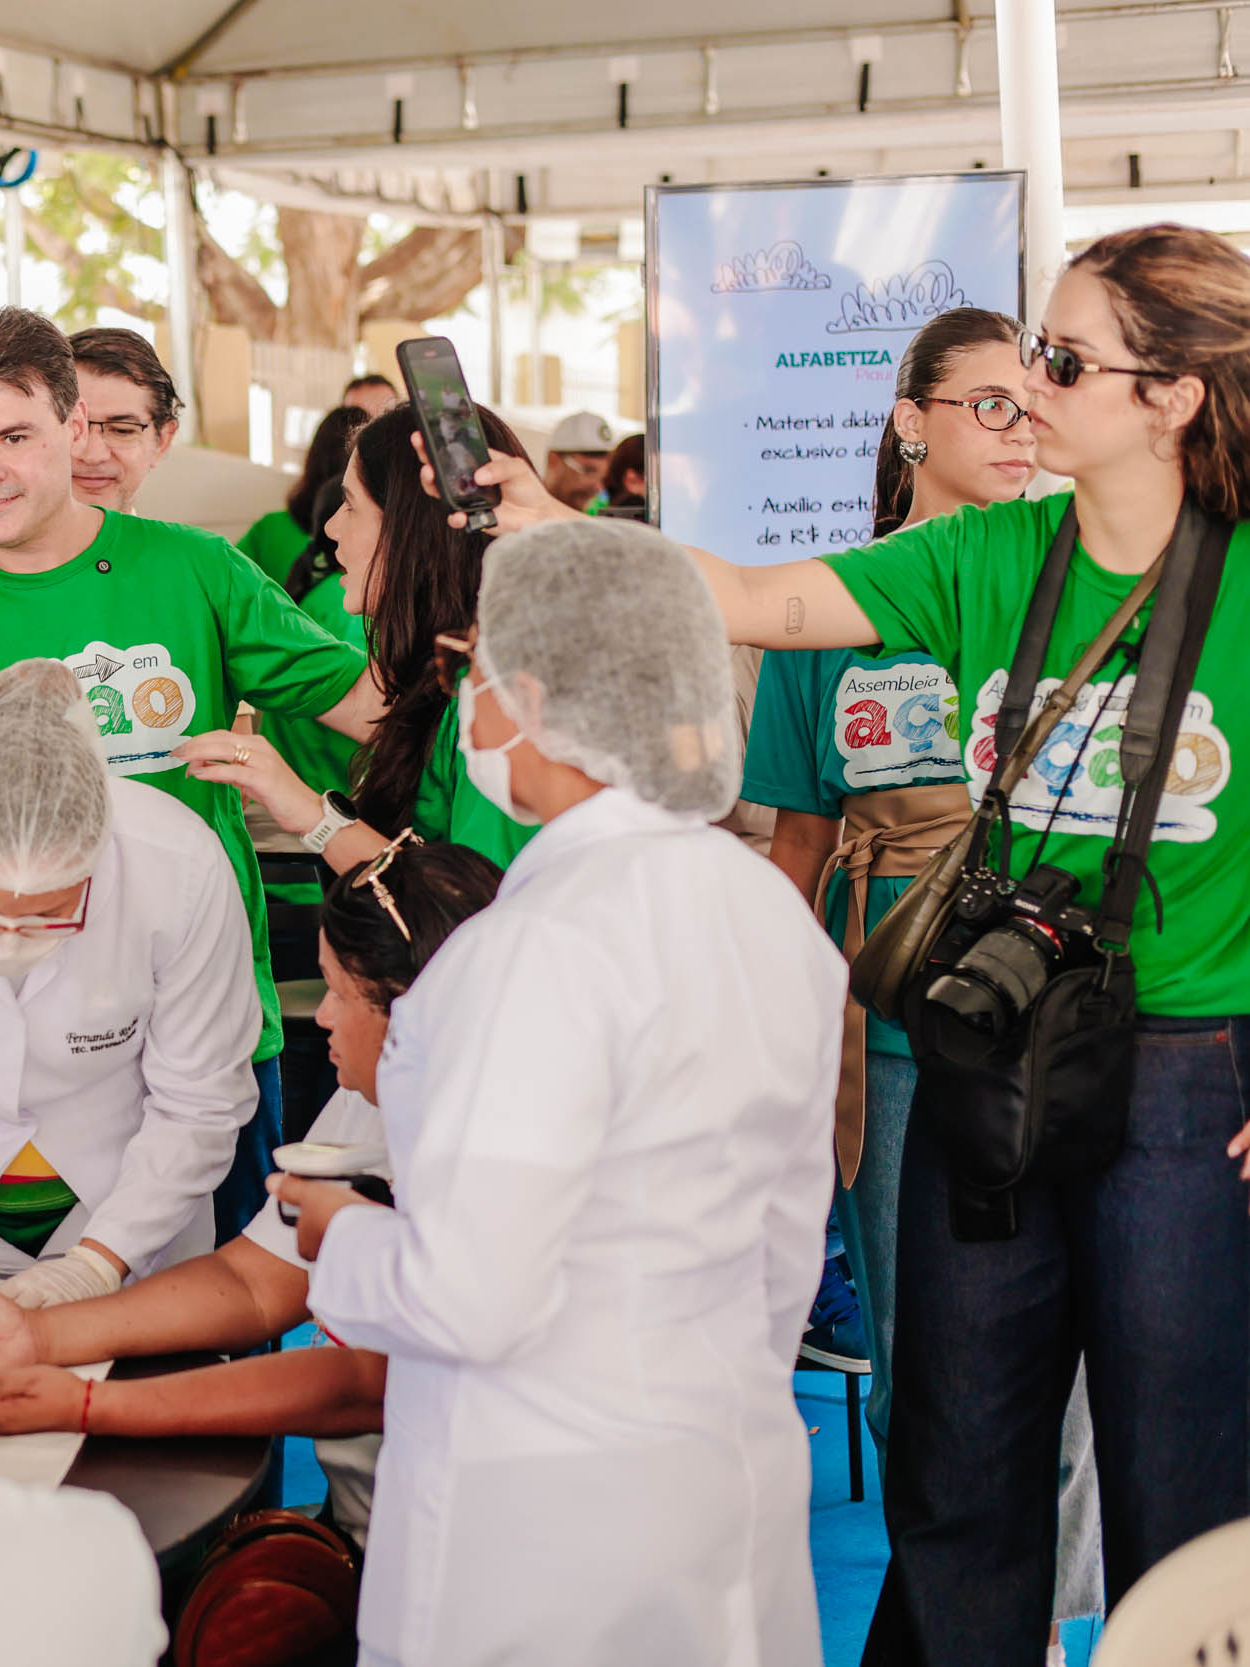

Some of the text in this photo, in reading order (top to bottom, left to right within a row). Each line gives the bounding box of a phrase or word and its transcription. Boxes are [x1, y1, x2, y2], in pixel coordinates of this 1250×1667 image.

[775, 350, 892, 368] ALFABETIZA
[756, 414, 834, 430] Material
[761, 444, 848, 460] exclusivo
[756, 527, 781, 545] de
[791, 523, 820, 545] R$
[133, 654, 159, 669] em
[845, 675, 939, 694] Assembleia
